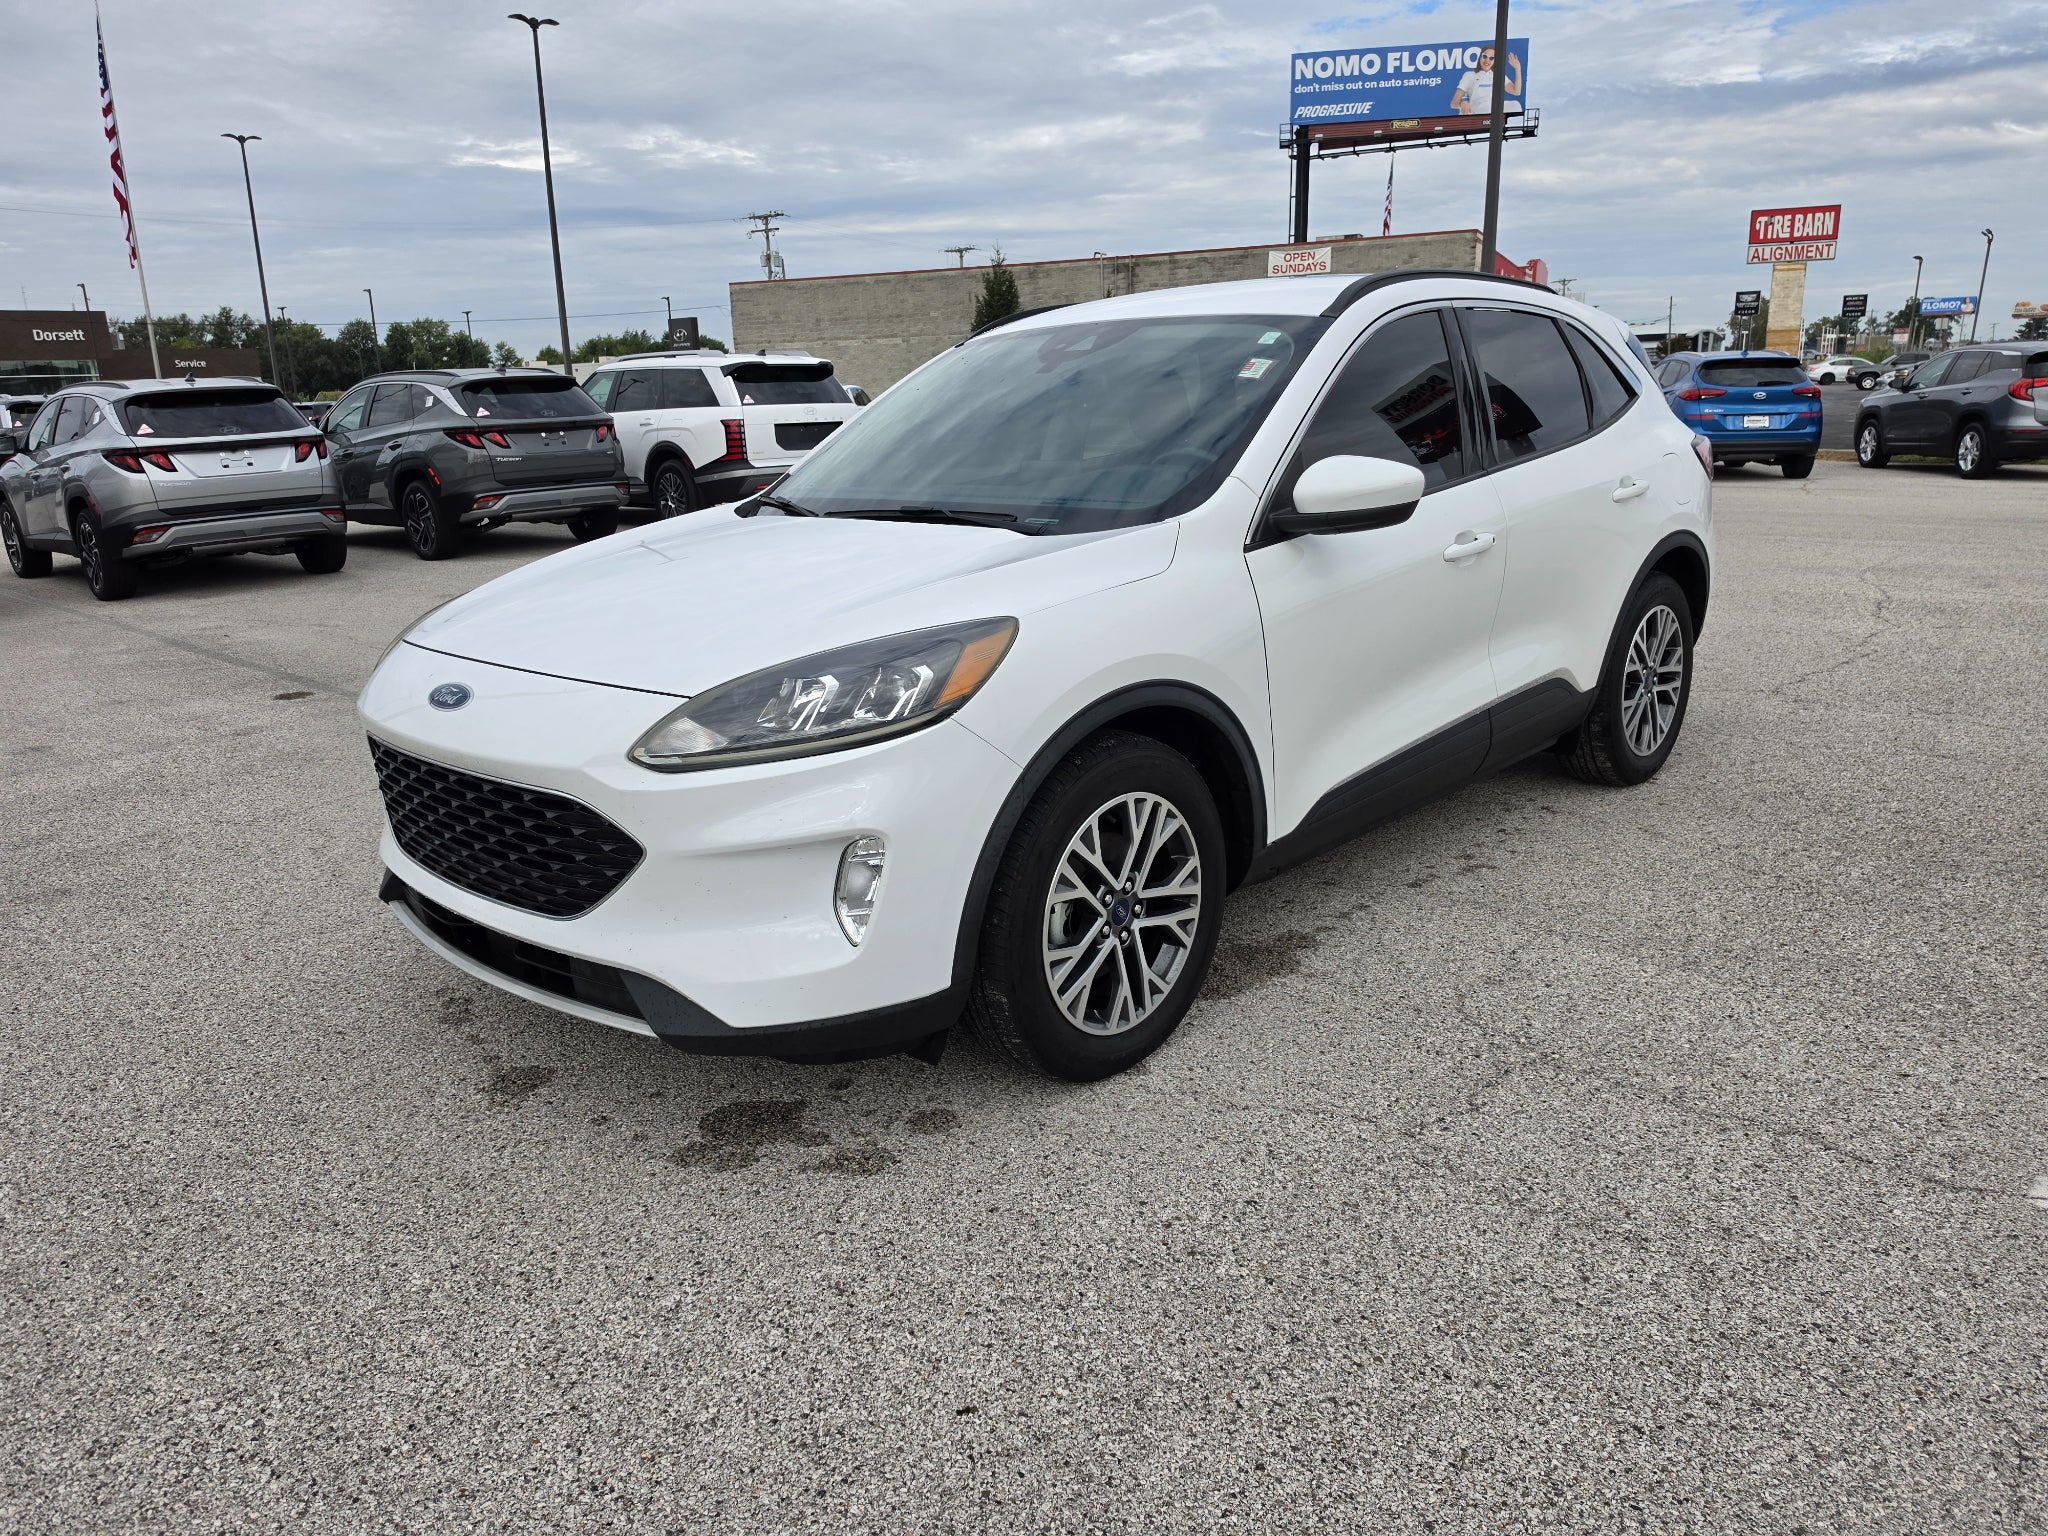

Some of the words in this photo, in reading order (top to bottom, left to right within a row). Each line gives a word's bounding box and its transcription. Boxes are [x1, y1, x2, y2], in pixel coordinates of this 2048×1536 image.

[1294, 53, 1381, 80] NOMO
[1387, 46, 1482, 74] FLOMO
[1294, 82, 1320, 94] don't
[1321, 82, 1344, 92] miss
[1345, 80, 1363, 90] out
[1379, 78, 1402, 88] auto
[1403, 76, 1442, 87] savings
[1294, 101, 1374, 119] PROGRESSIVE
[1793, 211, 1835, 238] BARN
[1283, 251, 1316, 263] OPEN
[1751, 243, 1834, 262] ALIGNMENT
[1272, 261, 1327, 275] SUNDAYS
[32, 329, 86, 341] Dorsett
[175, 359, 207, 368] Service
